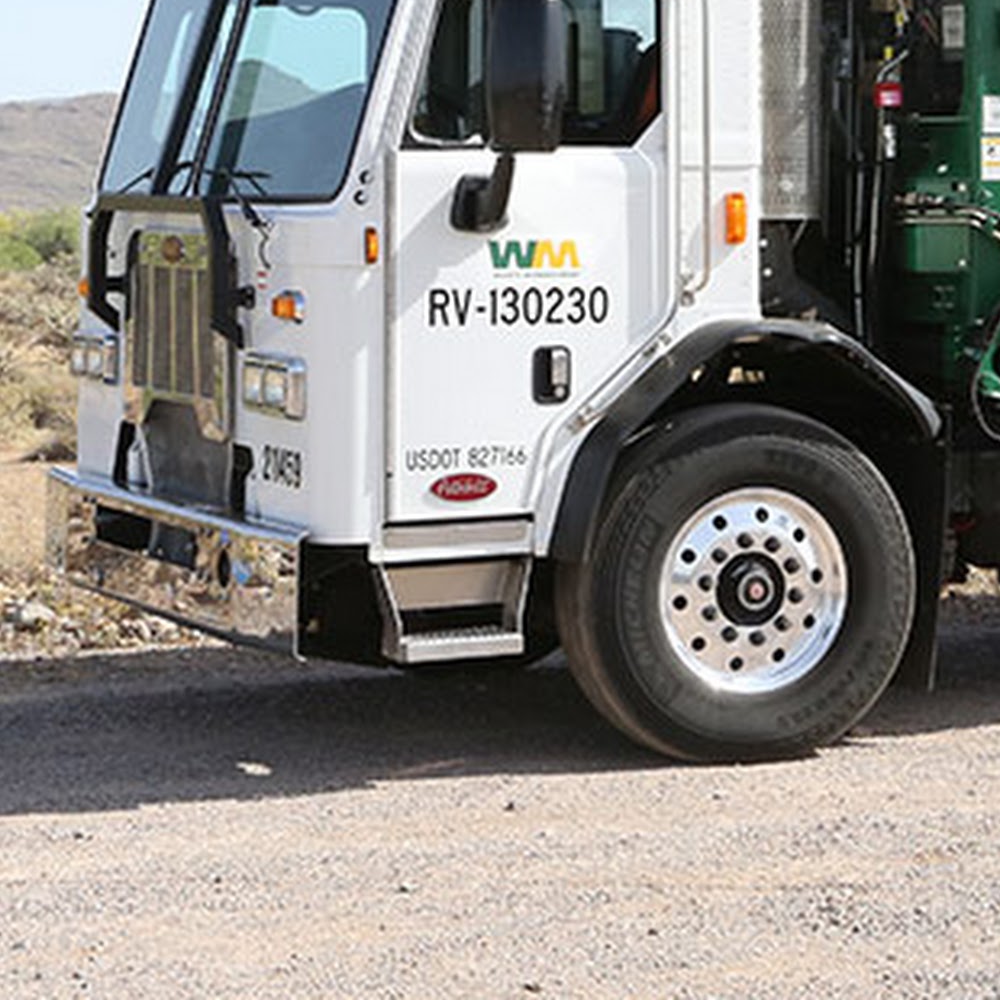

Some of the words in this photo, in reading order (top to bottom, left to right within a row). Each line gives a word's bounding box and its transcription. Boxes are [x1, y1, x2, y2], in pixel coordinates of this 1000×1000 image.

[487, 239, 580, 268] WM
[428, 286, 609, 326] RV-130230
[405, 448, 460, 471] USDOT
